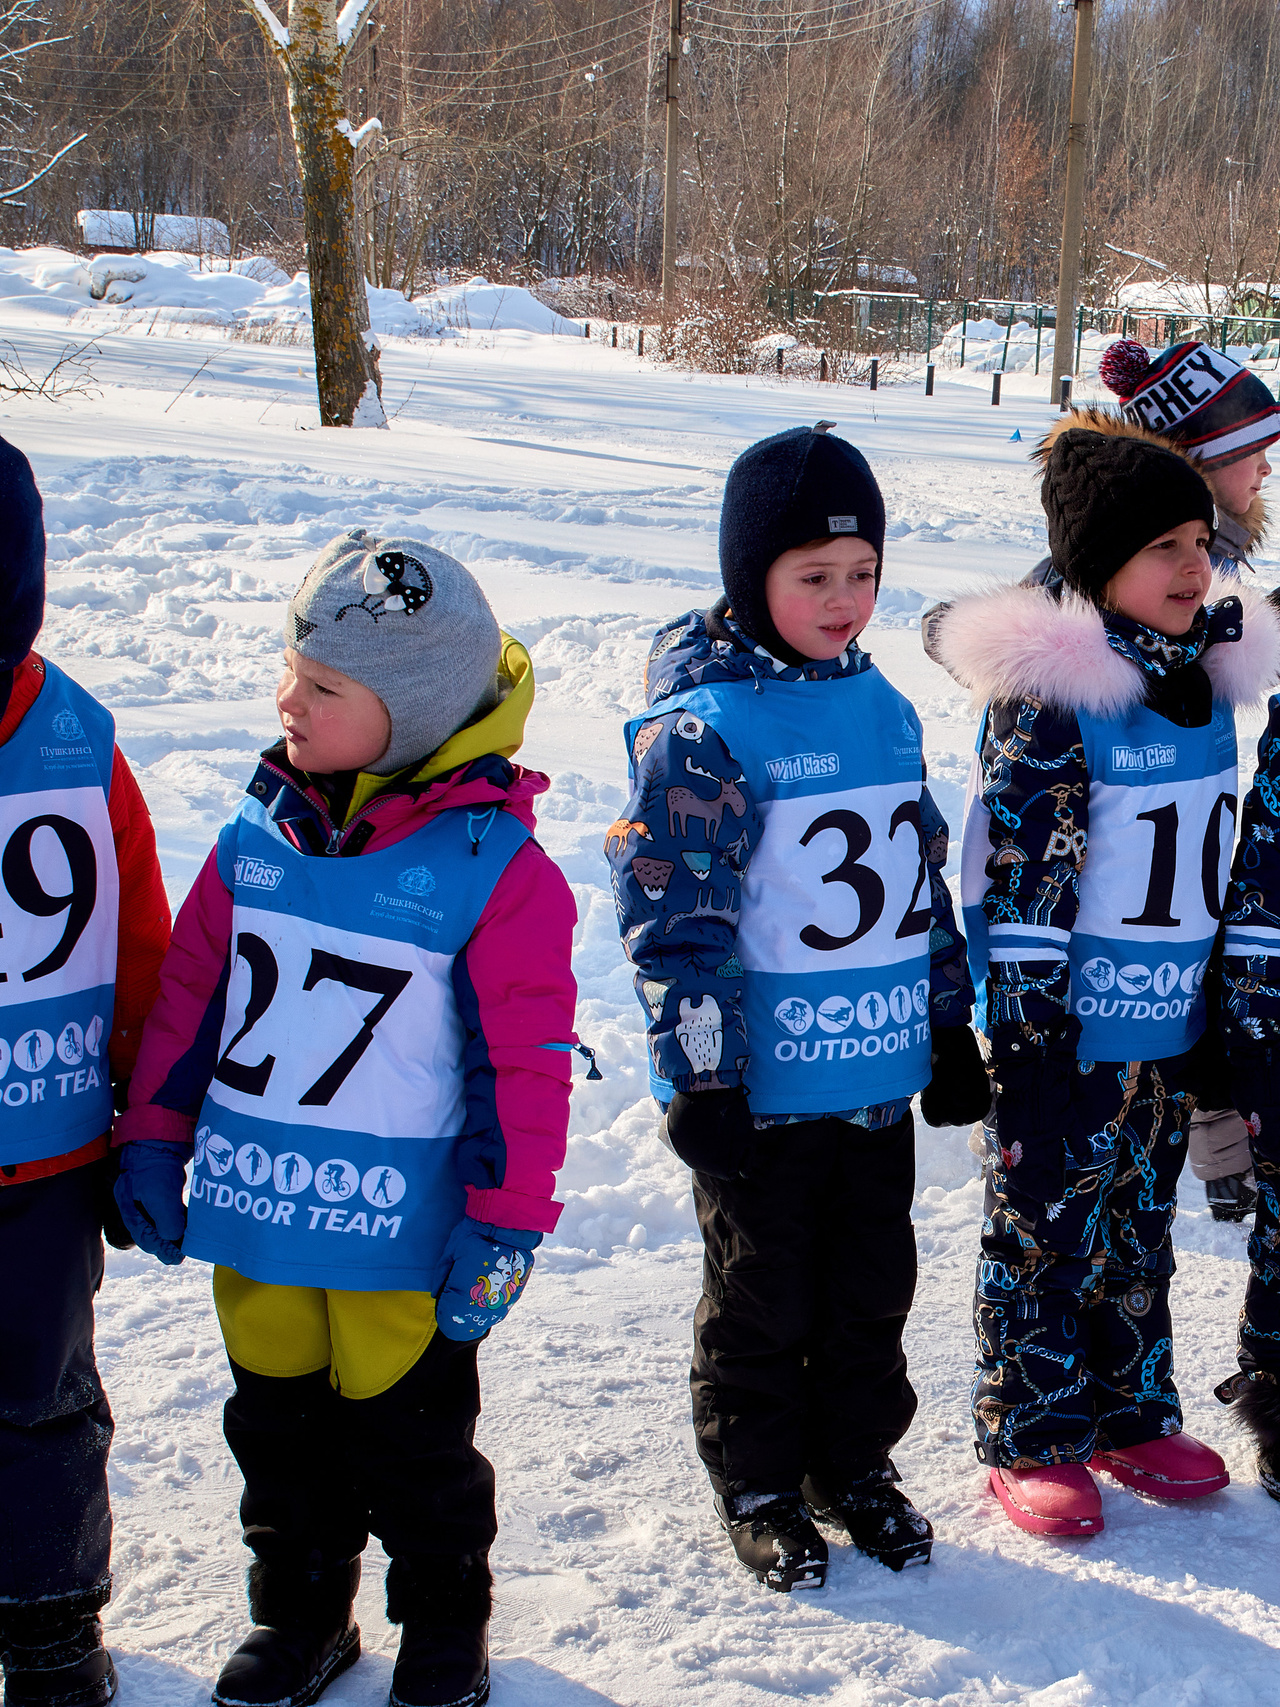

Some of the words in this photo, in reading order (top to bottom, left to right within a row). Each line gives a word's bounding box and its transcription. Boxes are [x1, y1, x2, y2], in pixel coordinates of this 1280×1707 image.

[803, 755, 836, 776] Class
[1146, 746, 1175, 767] Class
[243, 860, 281, 888] Class
[799, 800, 931, 951] 32
[1121, 792, 1237, 926] 10
[0, 814, 97, 982] 9
[373, 892, 444, 920] Пушкинский
[213, 932, 413, 1106] 27
[1076, 996, 1192, 1021] OUTDOOR
[774, 1028, 910, 1063] OUTDOOR
[55, 1064, 104, 1098] TEA
[191, 1174, 296, 1226] UTDOOR
[307, 1205, 403, 1239] TEAM
